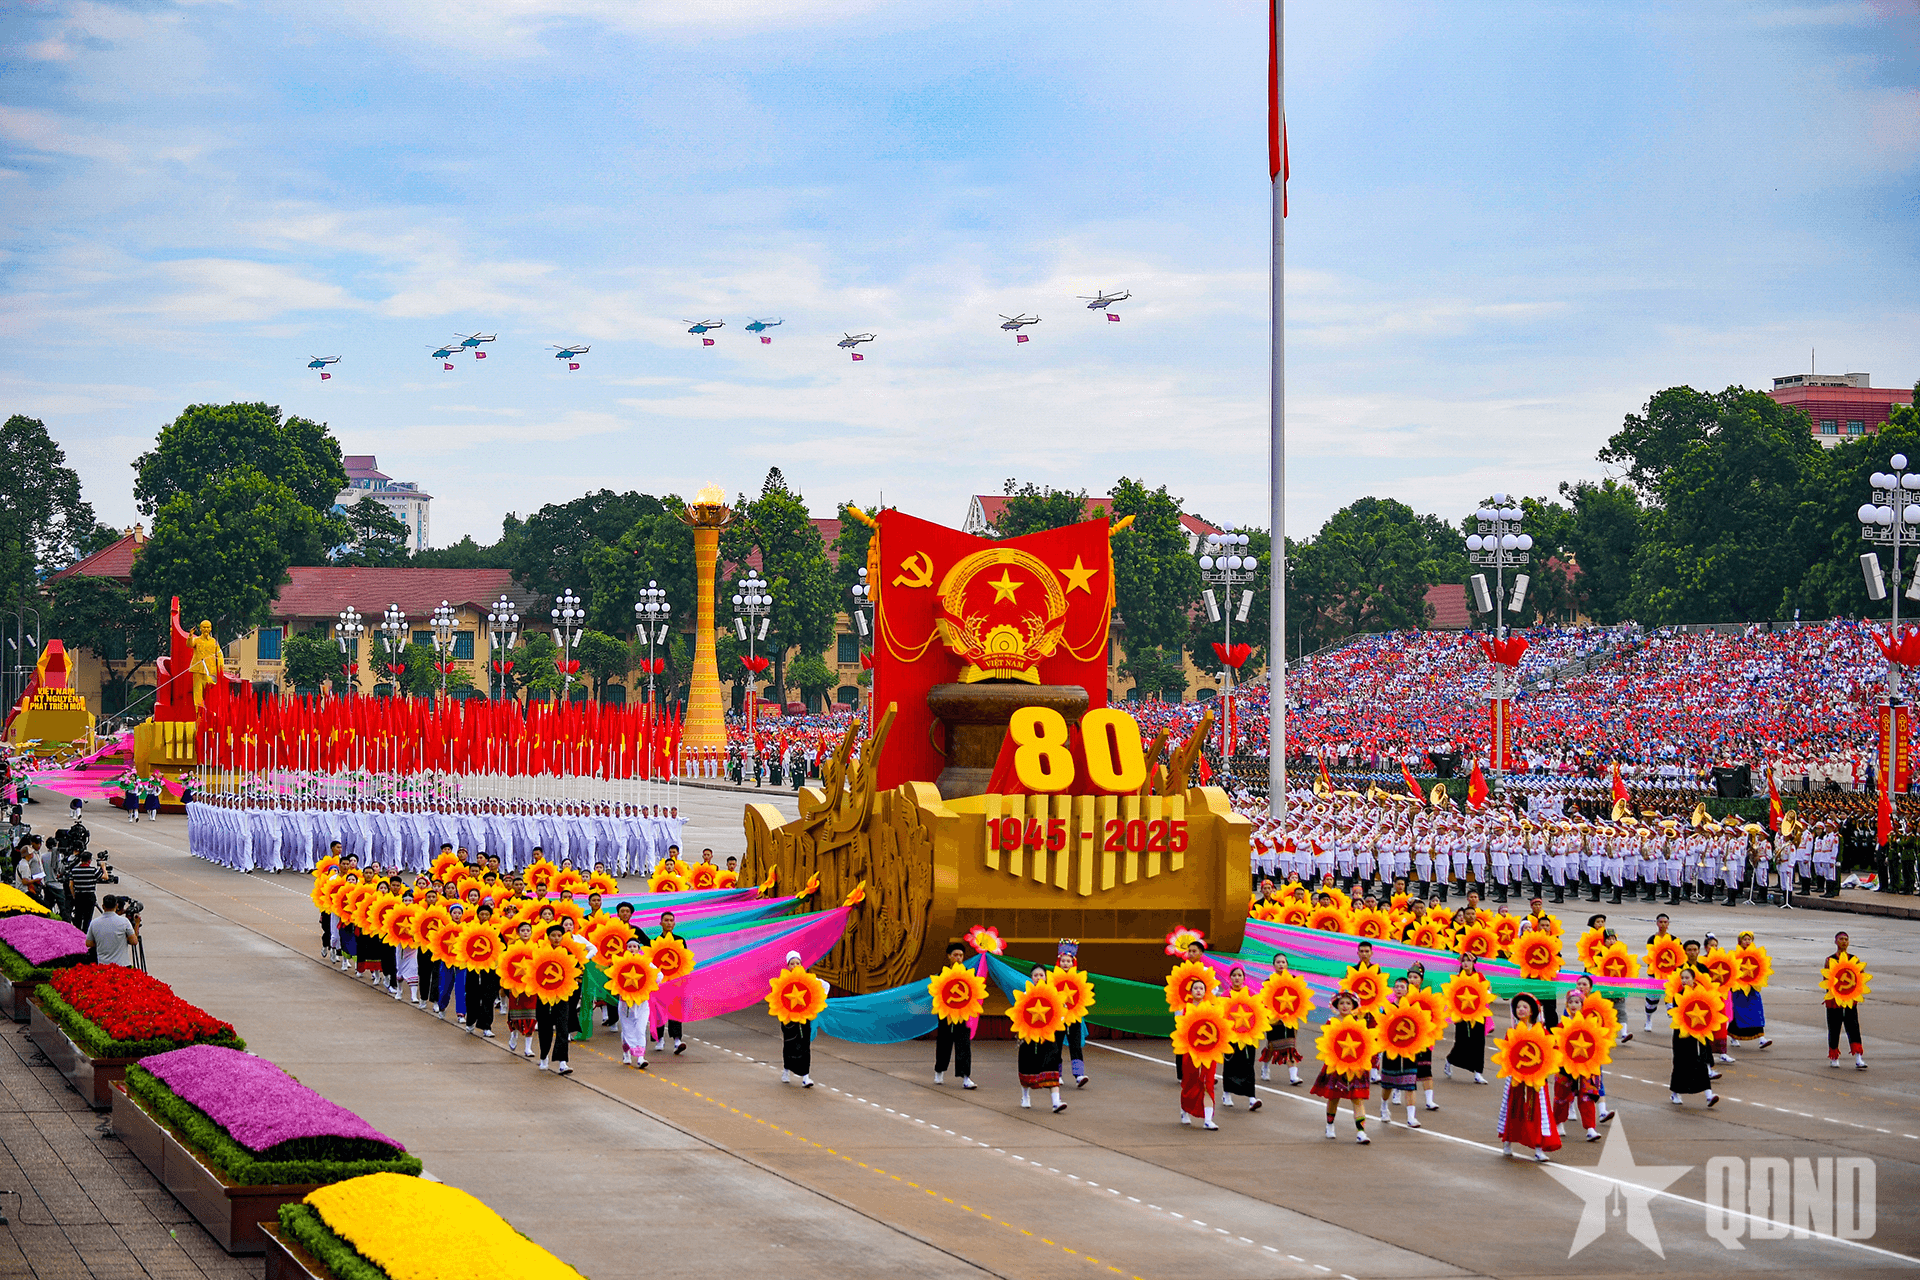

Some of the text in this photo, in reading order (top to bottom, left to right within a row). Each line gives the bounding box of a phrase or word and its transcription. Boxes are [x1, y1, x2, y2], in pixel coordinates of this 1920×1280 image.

[1005, 659, 1025, 669] NAM
[56, 687, 75, 695] NAM
[1010, 706, 1147, 793] 80
[987, 817, 1067, 851] 1945
[1103, 819, 1189, 853] 2025
